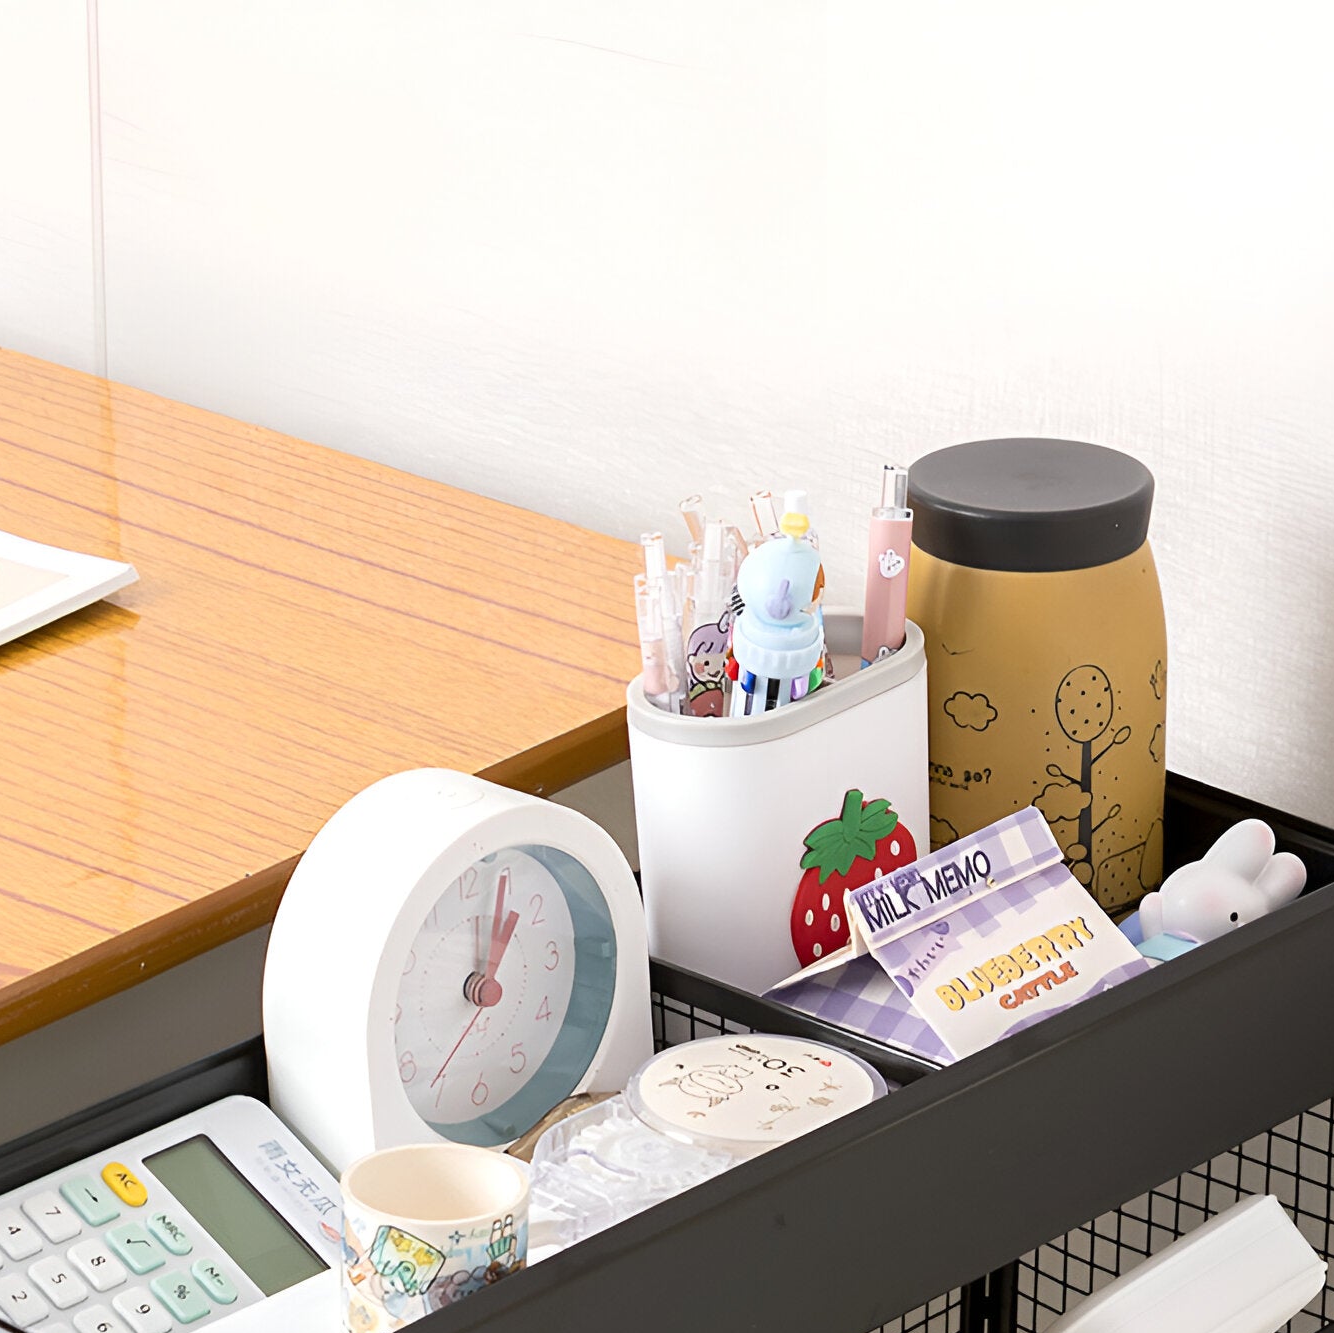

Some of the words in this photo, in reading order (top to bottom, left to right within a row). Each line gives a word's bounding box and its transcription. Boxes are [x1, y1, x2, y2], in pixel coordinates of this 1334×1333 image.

[458, 867, 479, 900] 12
[861, 882, 920, 933] MILK
[924, 850, 991, 905] MEMO
[529, 894, 545, 925] 2
[545, 941, 559, 971] 3
[935, 916, 1094, 1011] BLUEBERRY
[535, 996, 551, 1021] 4
[398, 1051, 417, 1083] 8
[508, 1043, 526, 1074] 5
[471, 1072, 489, 1105] 6
[116, 1171, 138, 1190] AC
[44, 1206, 61, 1218] 7
[7, 1224, 21, 1236] 4
[155, 1214, 187, 1243] MRC
[90, 1254, 106, 1268] 8
[51, 1272, 67, 1286] 5
[12, 1289, 28, 1304] 2
[135, 1302, 151, 1317] 9
